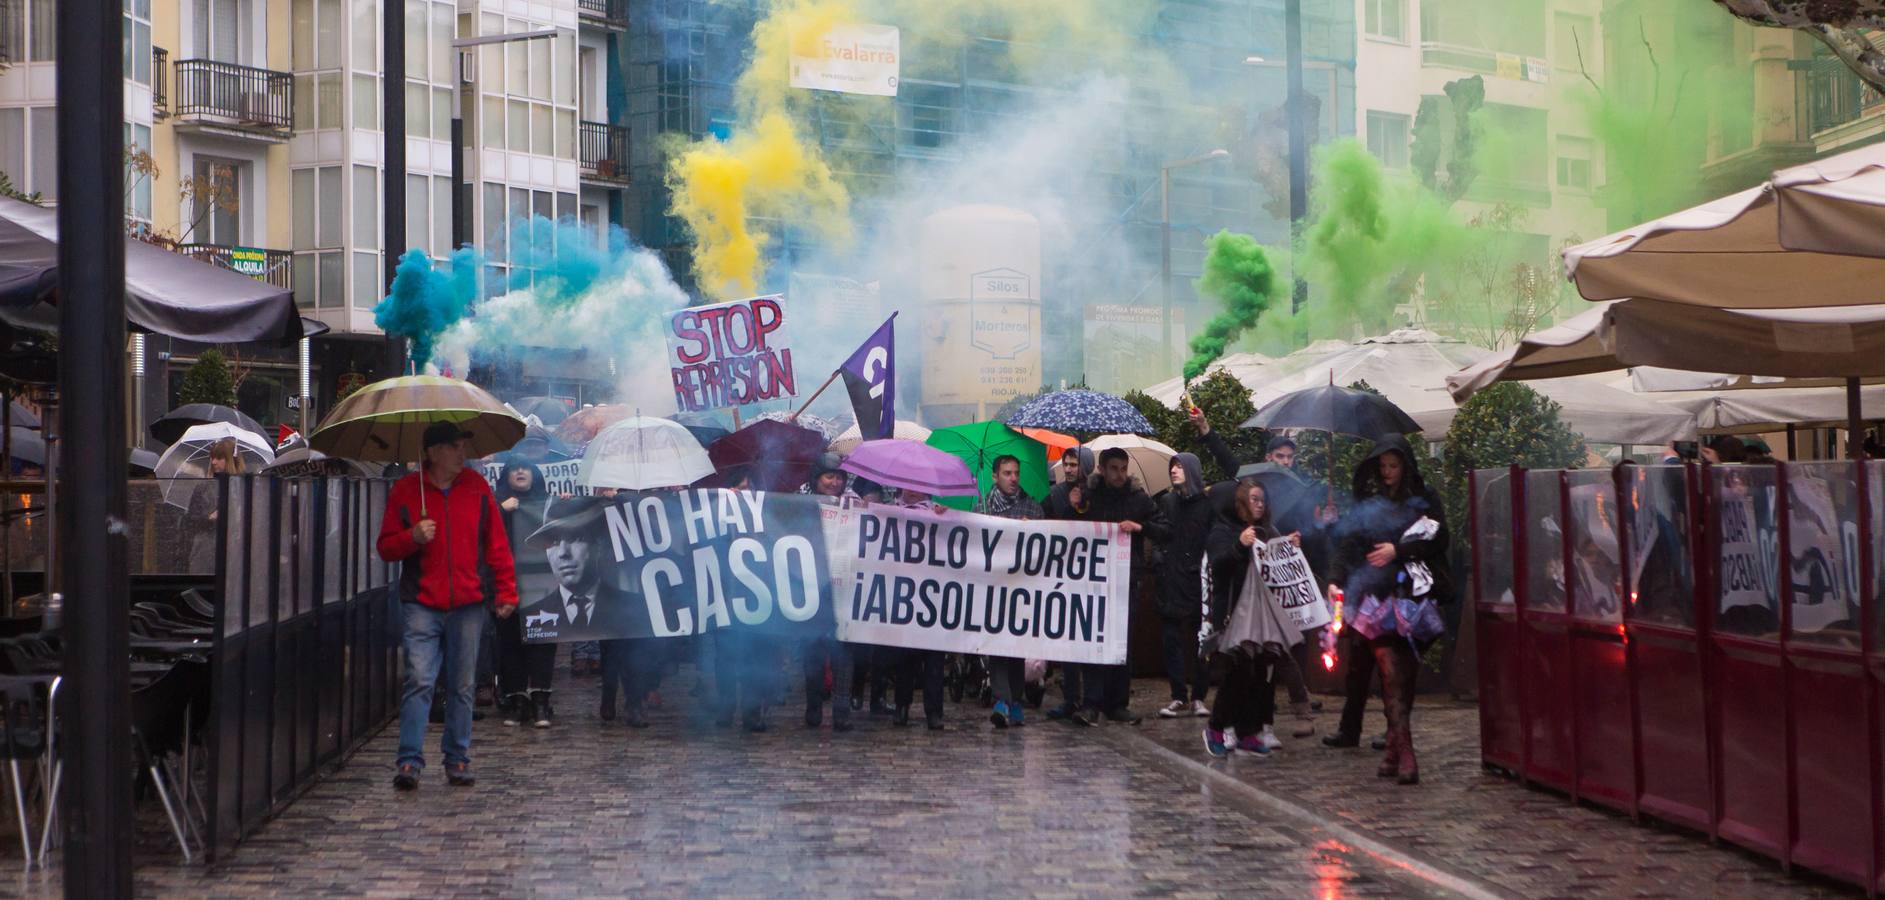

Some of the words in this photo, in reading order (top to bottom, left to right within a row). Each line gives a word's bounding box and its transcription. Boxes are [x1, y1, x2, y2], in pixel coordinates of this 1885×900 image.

[233, 260, 265, 274] ALQUILA
[986, 279, 1019, 293] Silos
[671, 298, 783, 364] STOP
[671, 346, 796, 413] REPRESIÓN
[604, 496, 672, 563] NO
[679, 488, 765, 545] HAY
[858, 514, 970, 570] PABLO
[981, 528, 1004, 572] Y
[1008, 531, 1109, 583] JORGE
[640, 535, 820, 638] CASO
[851, 571, 1107, 643] ¡ABSOLUCIÓN!
